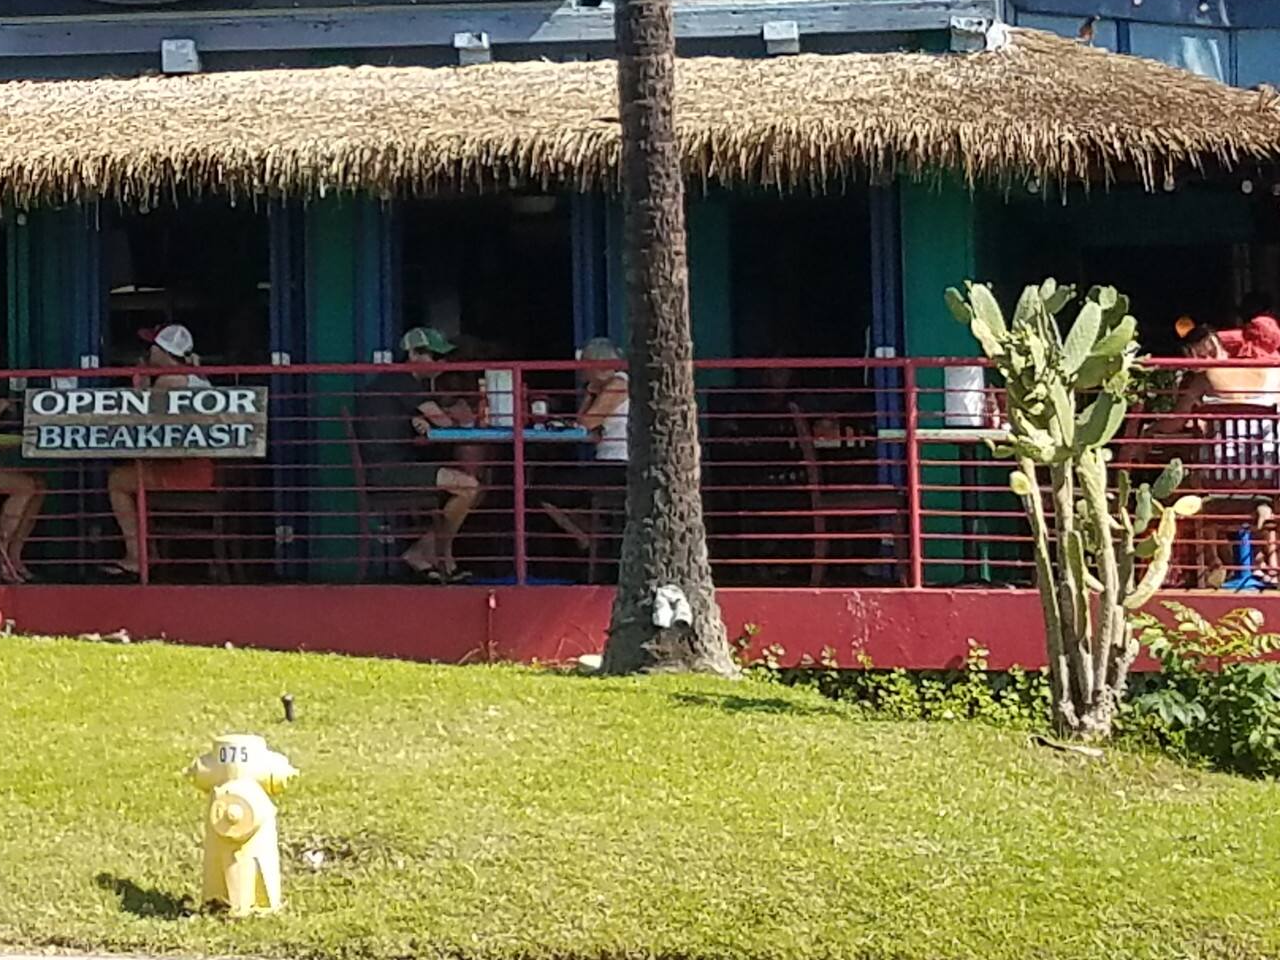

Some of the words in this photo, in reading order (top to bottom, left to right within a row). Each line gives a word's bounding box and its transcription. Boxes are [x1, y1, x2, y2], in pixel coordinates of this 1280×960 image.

[31, 390, 151, 416] OPEN
[167, 389, 257, 415] FOR
[37, 423, 255, 449] BREAKFAST
[219, 746, 248, 763] 075
